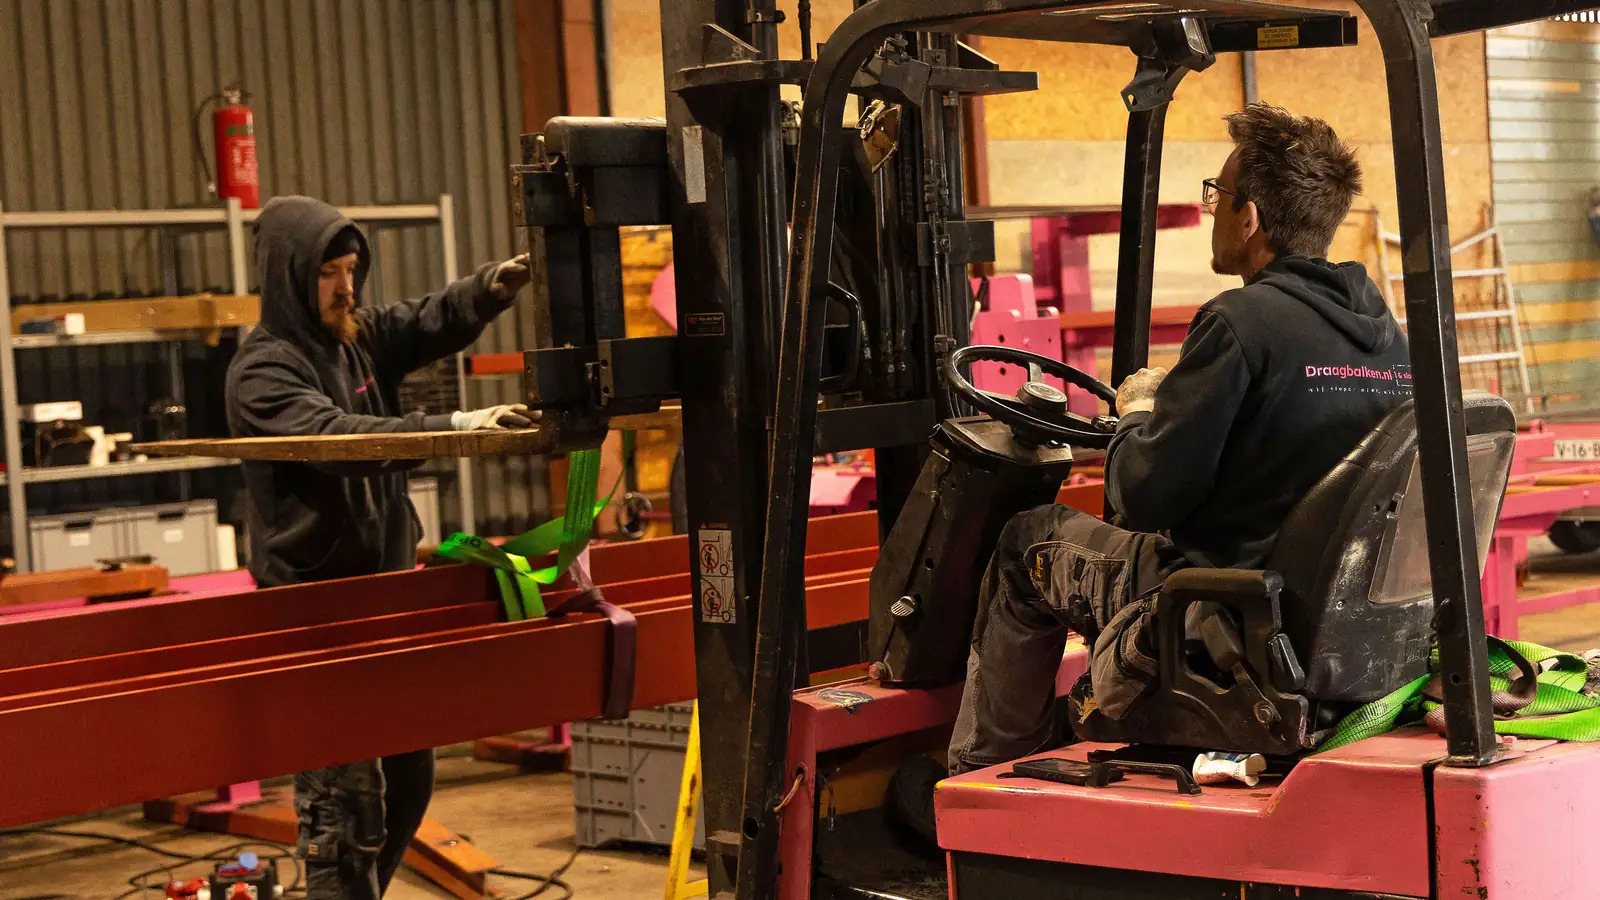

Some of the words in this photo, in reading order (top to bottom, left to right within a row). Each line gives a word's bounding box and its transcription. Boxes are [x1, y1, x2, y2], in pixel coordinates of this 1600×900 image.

[1305, 364, 1393, 380] Draagbalken.nl
[1403, 372, 1412, 380] slo
[1556, 443, 1600, 458] V-16-B
